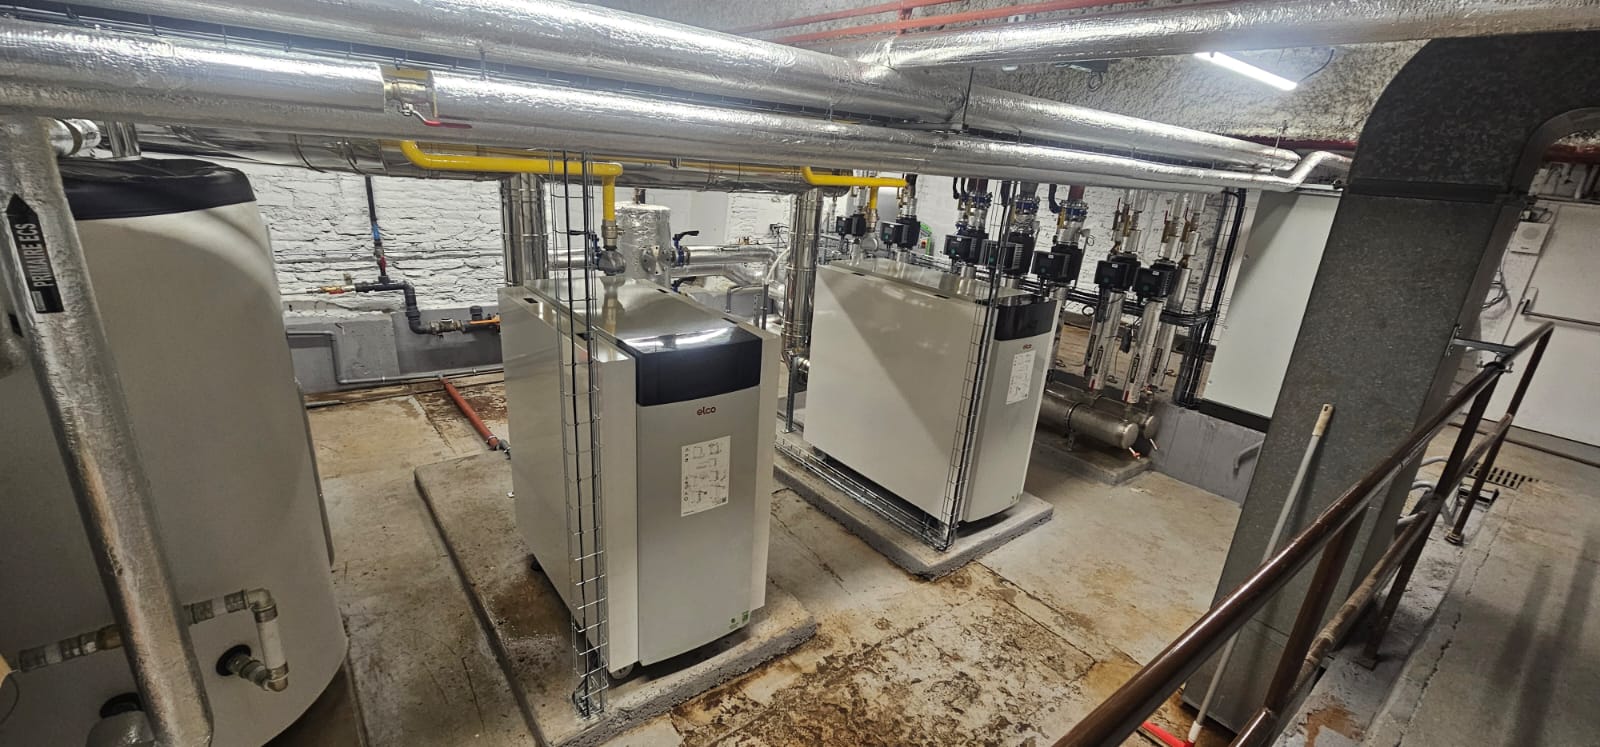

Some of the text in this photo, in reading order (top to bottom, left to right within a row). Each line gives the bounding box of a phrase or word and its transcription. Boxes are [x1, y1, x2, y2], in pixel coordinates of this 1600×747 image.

[15, 223, 55, 287] PRIMAIRE ECS
[696, 406, 716, 416] elco
